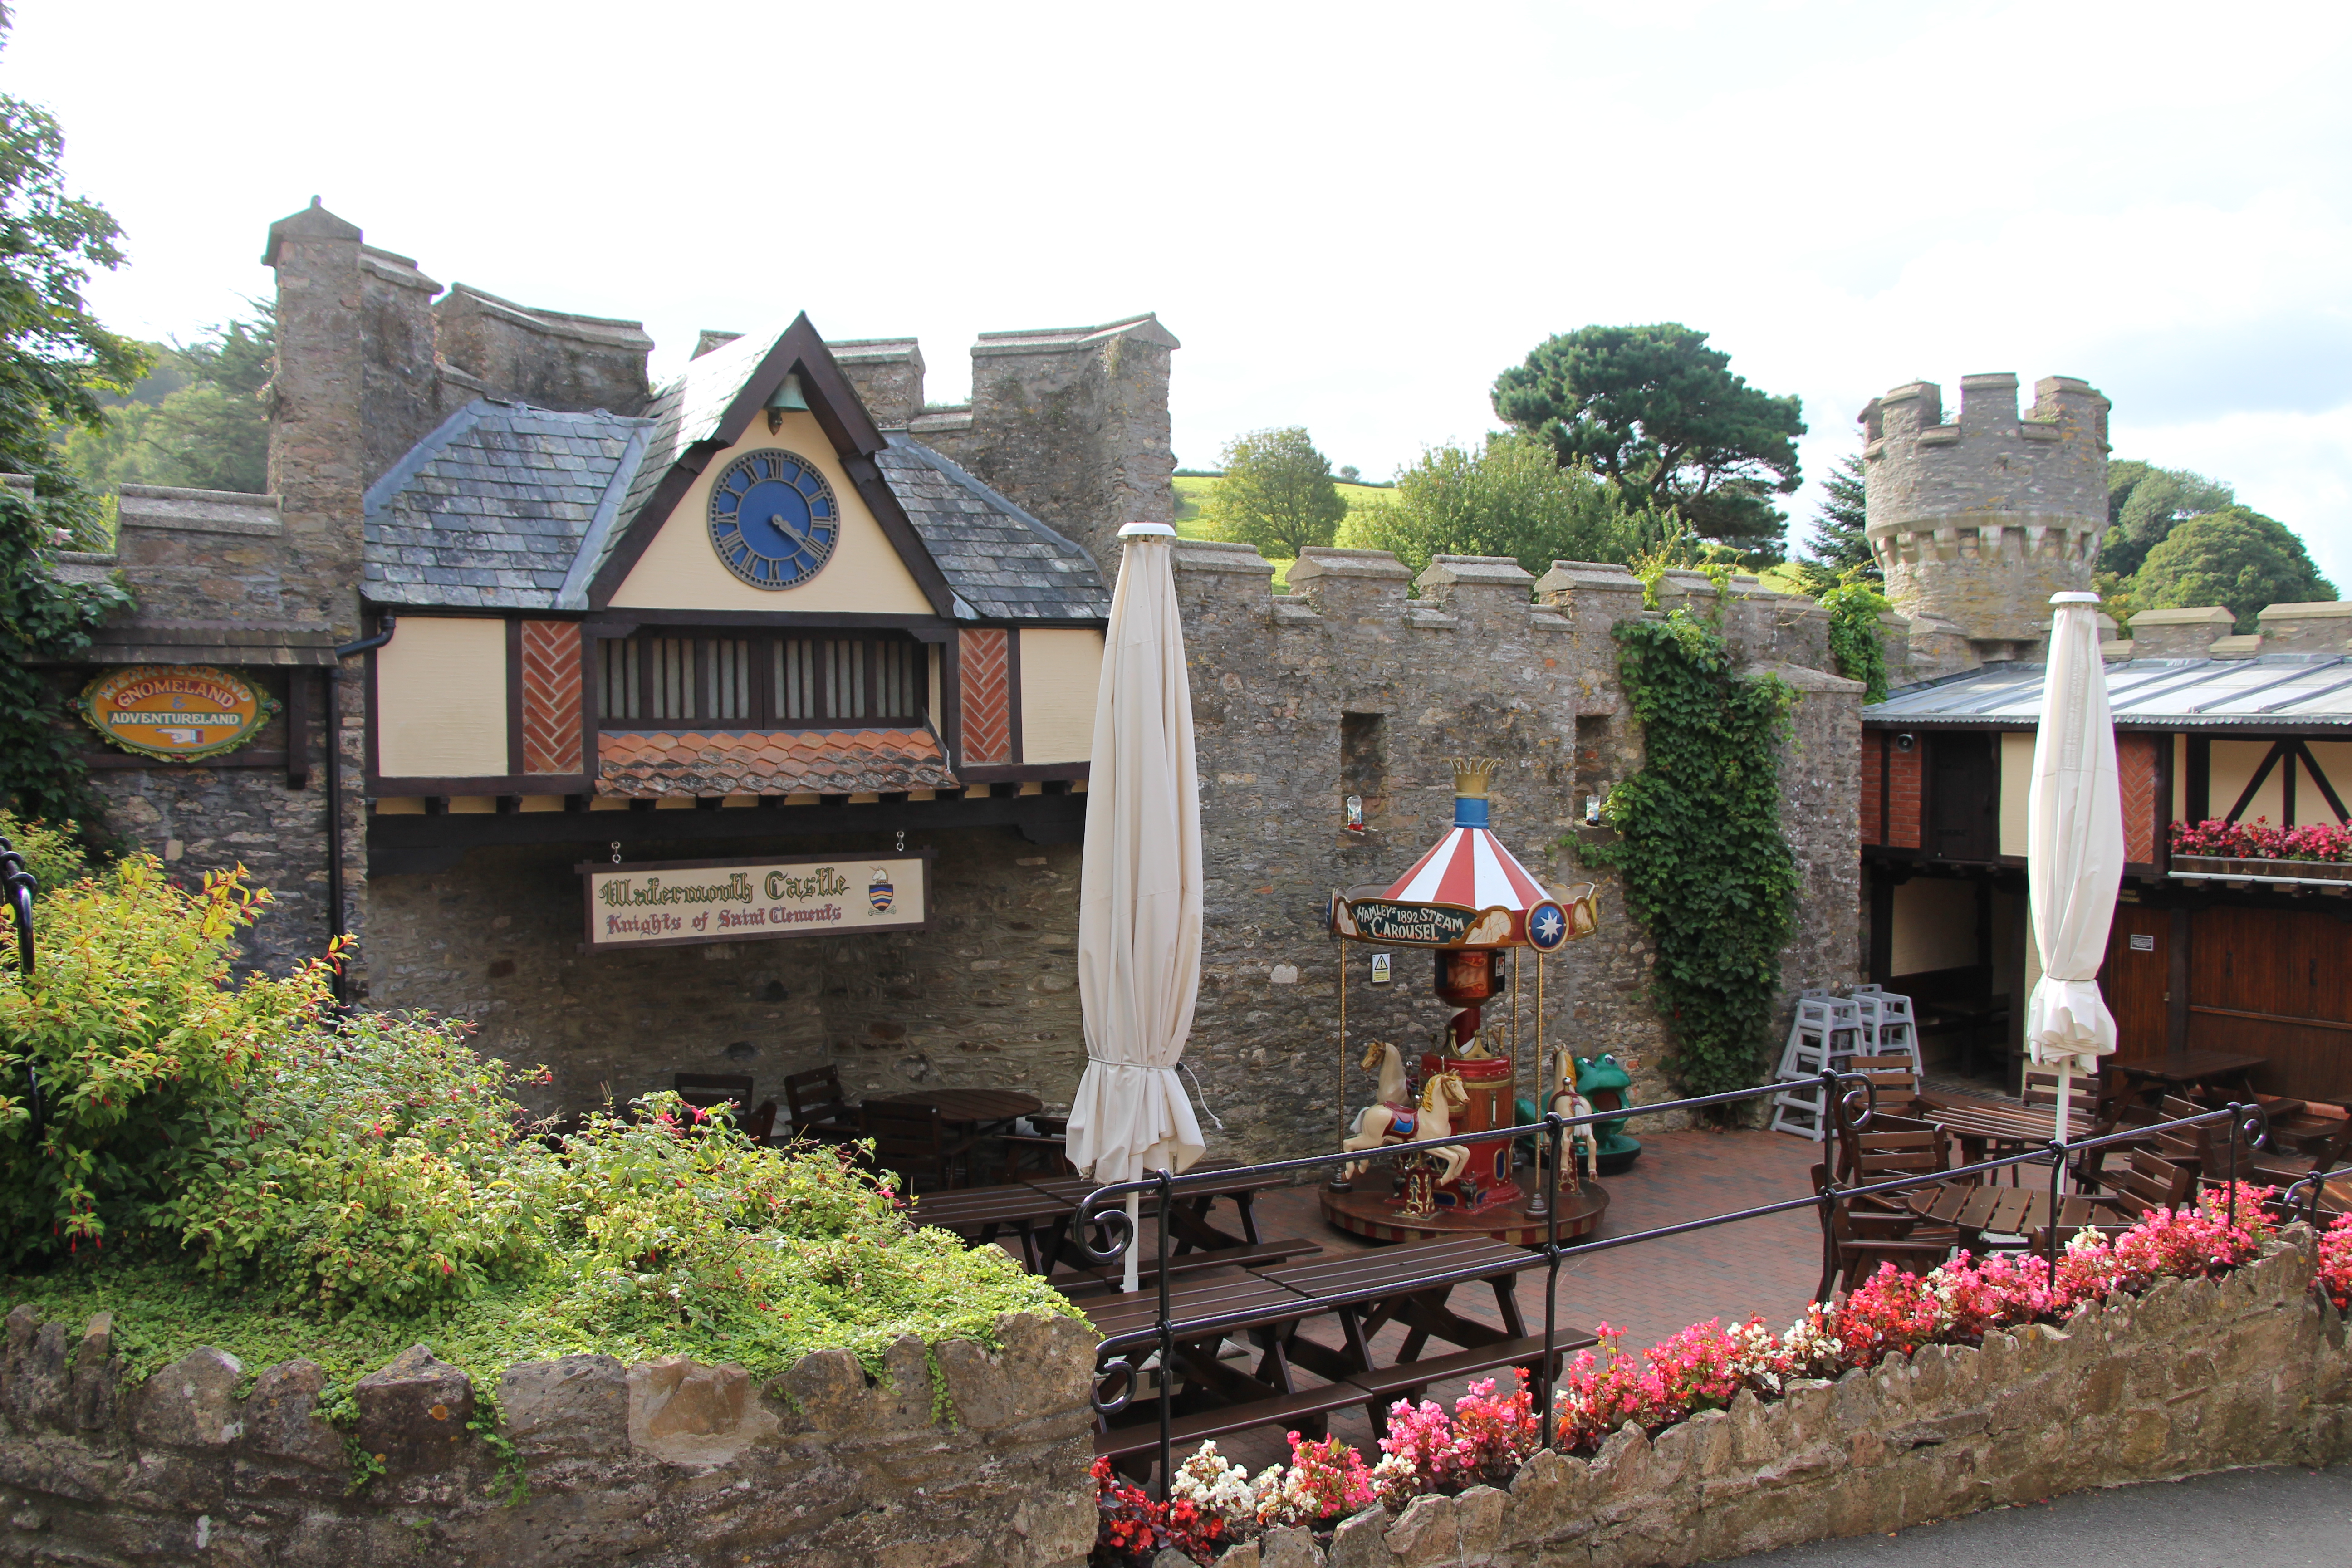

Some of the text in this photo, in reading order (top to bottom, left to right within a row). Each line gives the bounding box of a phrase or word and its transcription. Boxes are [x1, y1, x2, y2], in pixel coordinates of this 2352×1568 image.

[118, 680, 235, 707] GNOMELAND
[172, 696, 186, 709] &
[111, 712, 240, 725] ADVENTURELAND
[598, 867, 851, 907] Watermouth Castle
[606, 903, 842, 941] Knights of Saint Clements
[1369, 916, 1439, 941] CAROUSEL
[1397, 910, 1419, 923] 1892
[1419, 907, 1465, 931] STEAM
